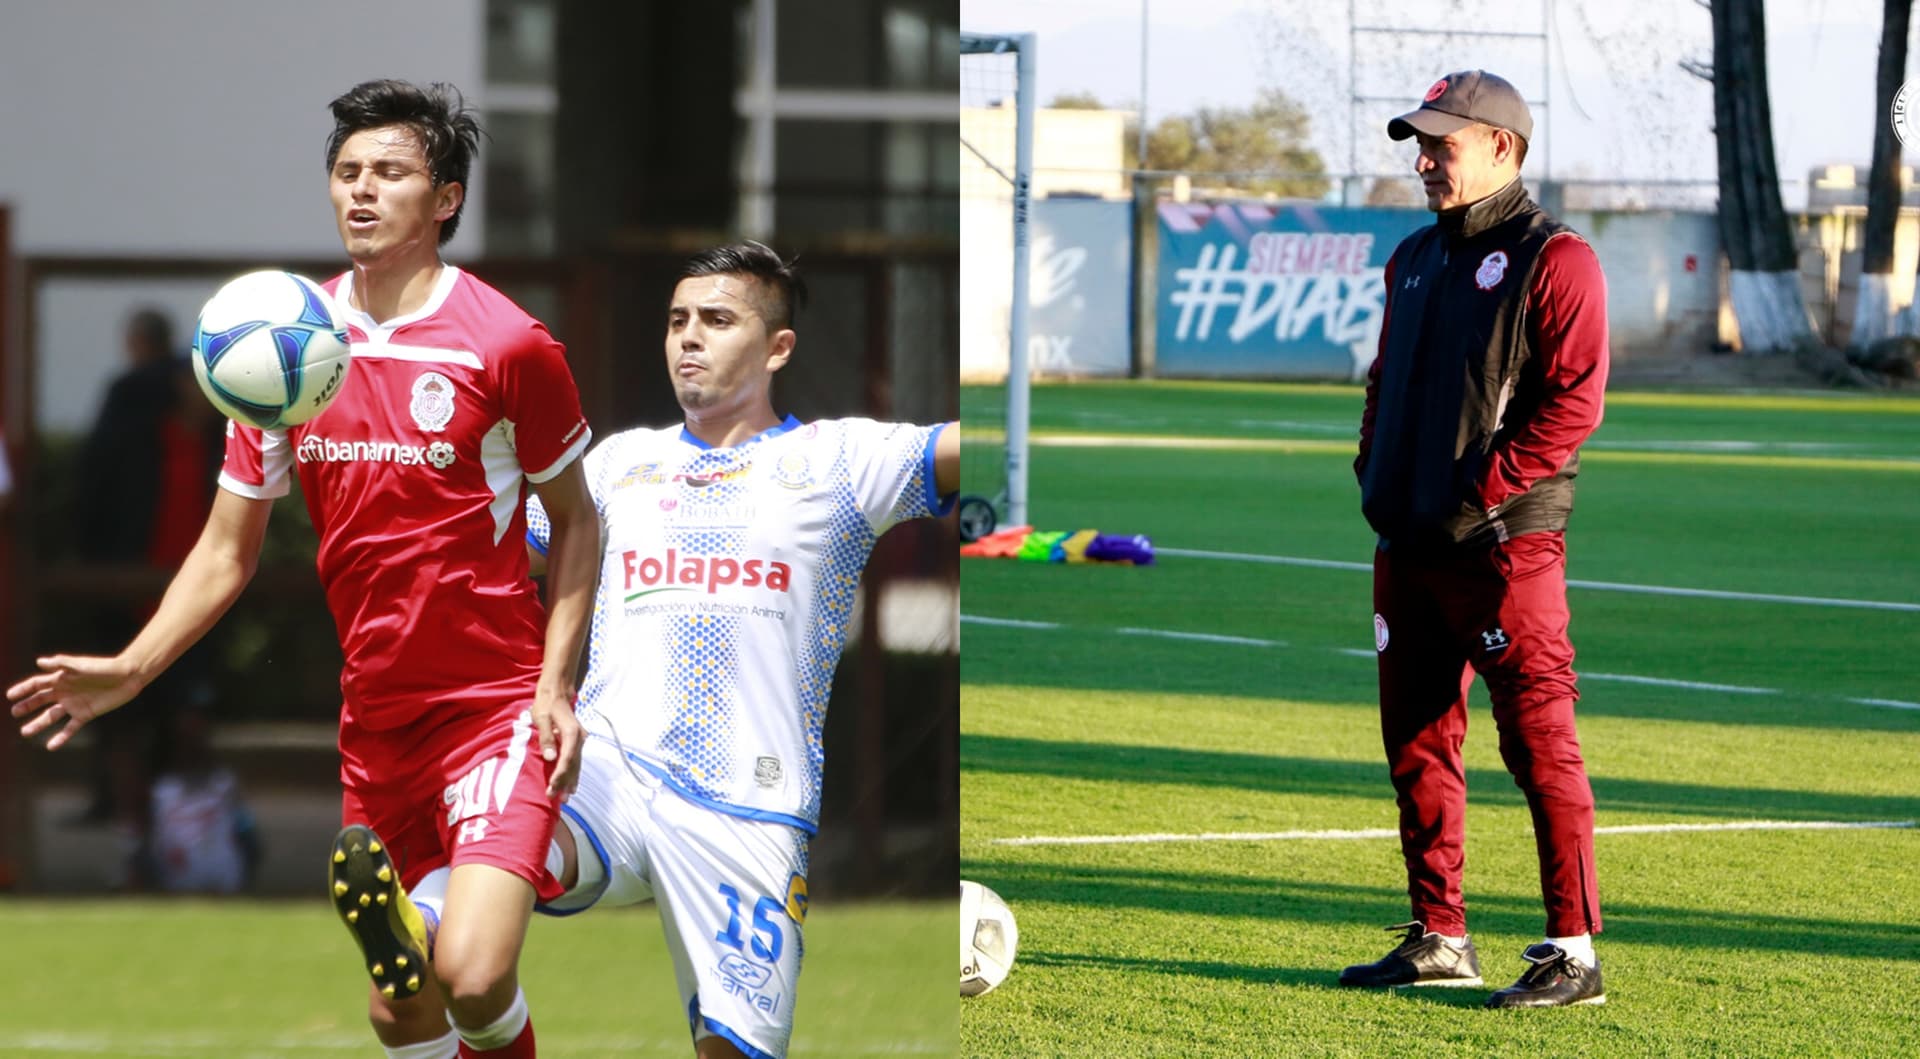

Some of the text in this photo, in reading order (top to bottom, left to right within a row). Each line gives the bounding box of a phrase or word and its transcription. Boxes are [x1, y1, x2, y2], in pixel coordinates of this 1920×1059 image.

[1250, 232, 1374, 275] SIEMPRE
[297, 434, 428, 466] citibanamex
[622, 548, 792, 594] Folapsa
[699, 602, 748, 616] Nutrición
[751, 606, 787, 620] Animal
[716, 883, 785, 964] 15
